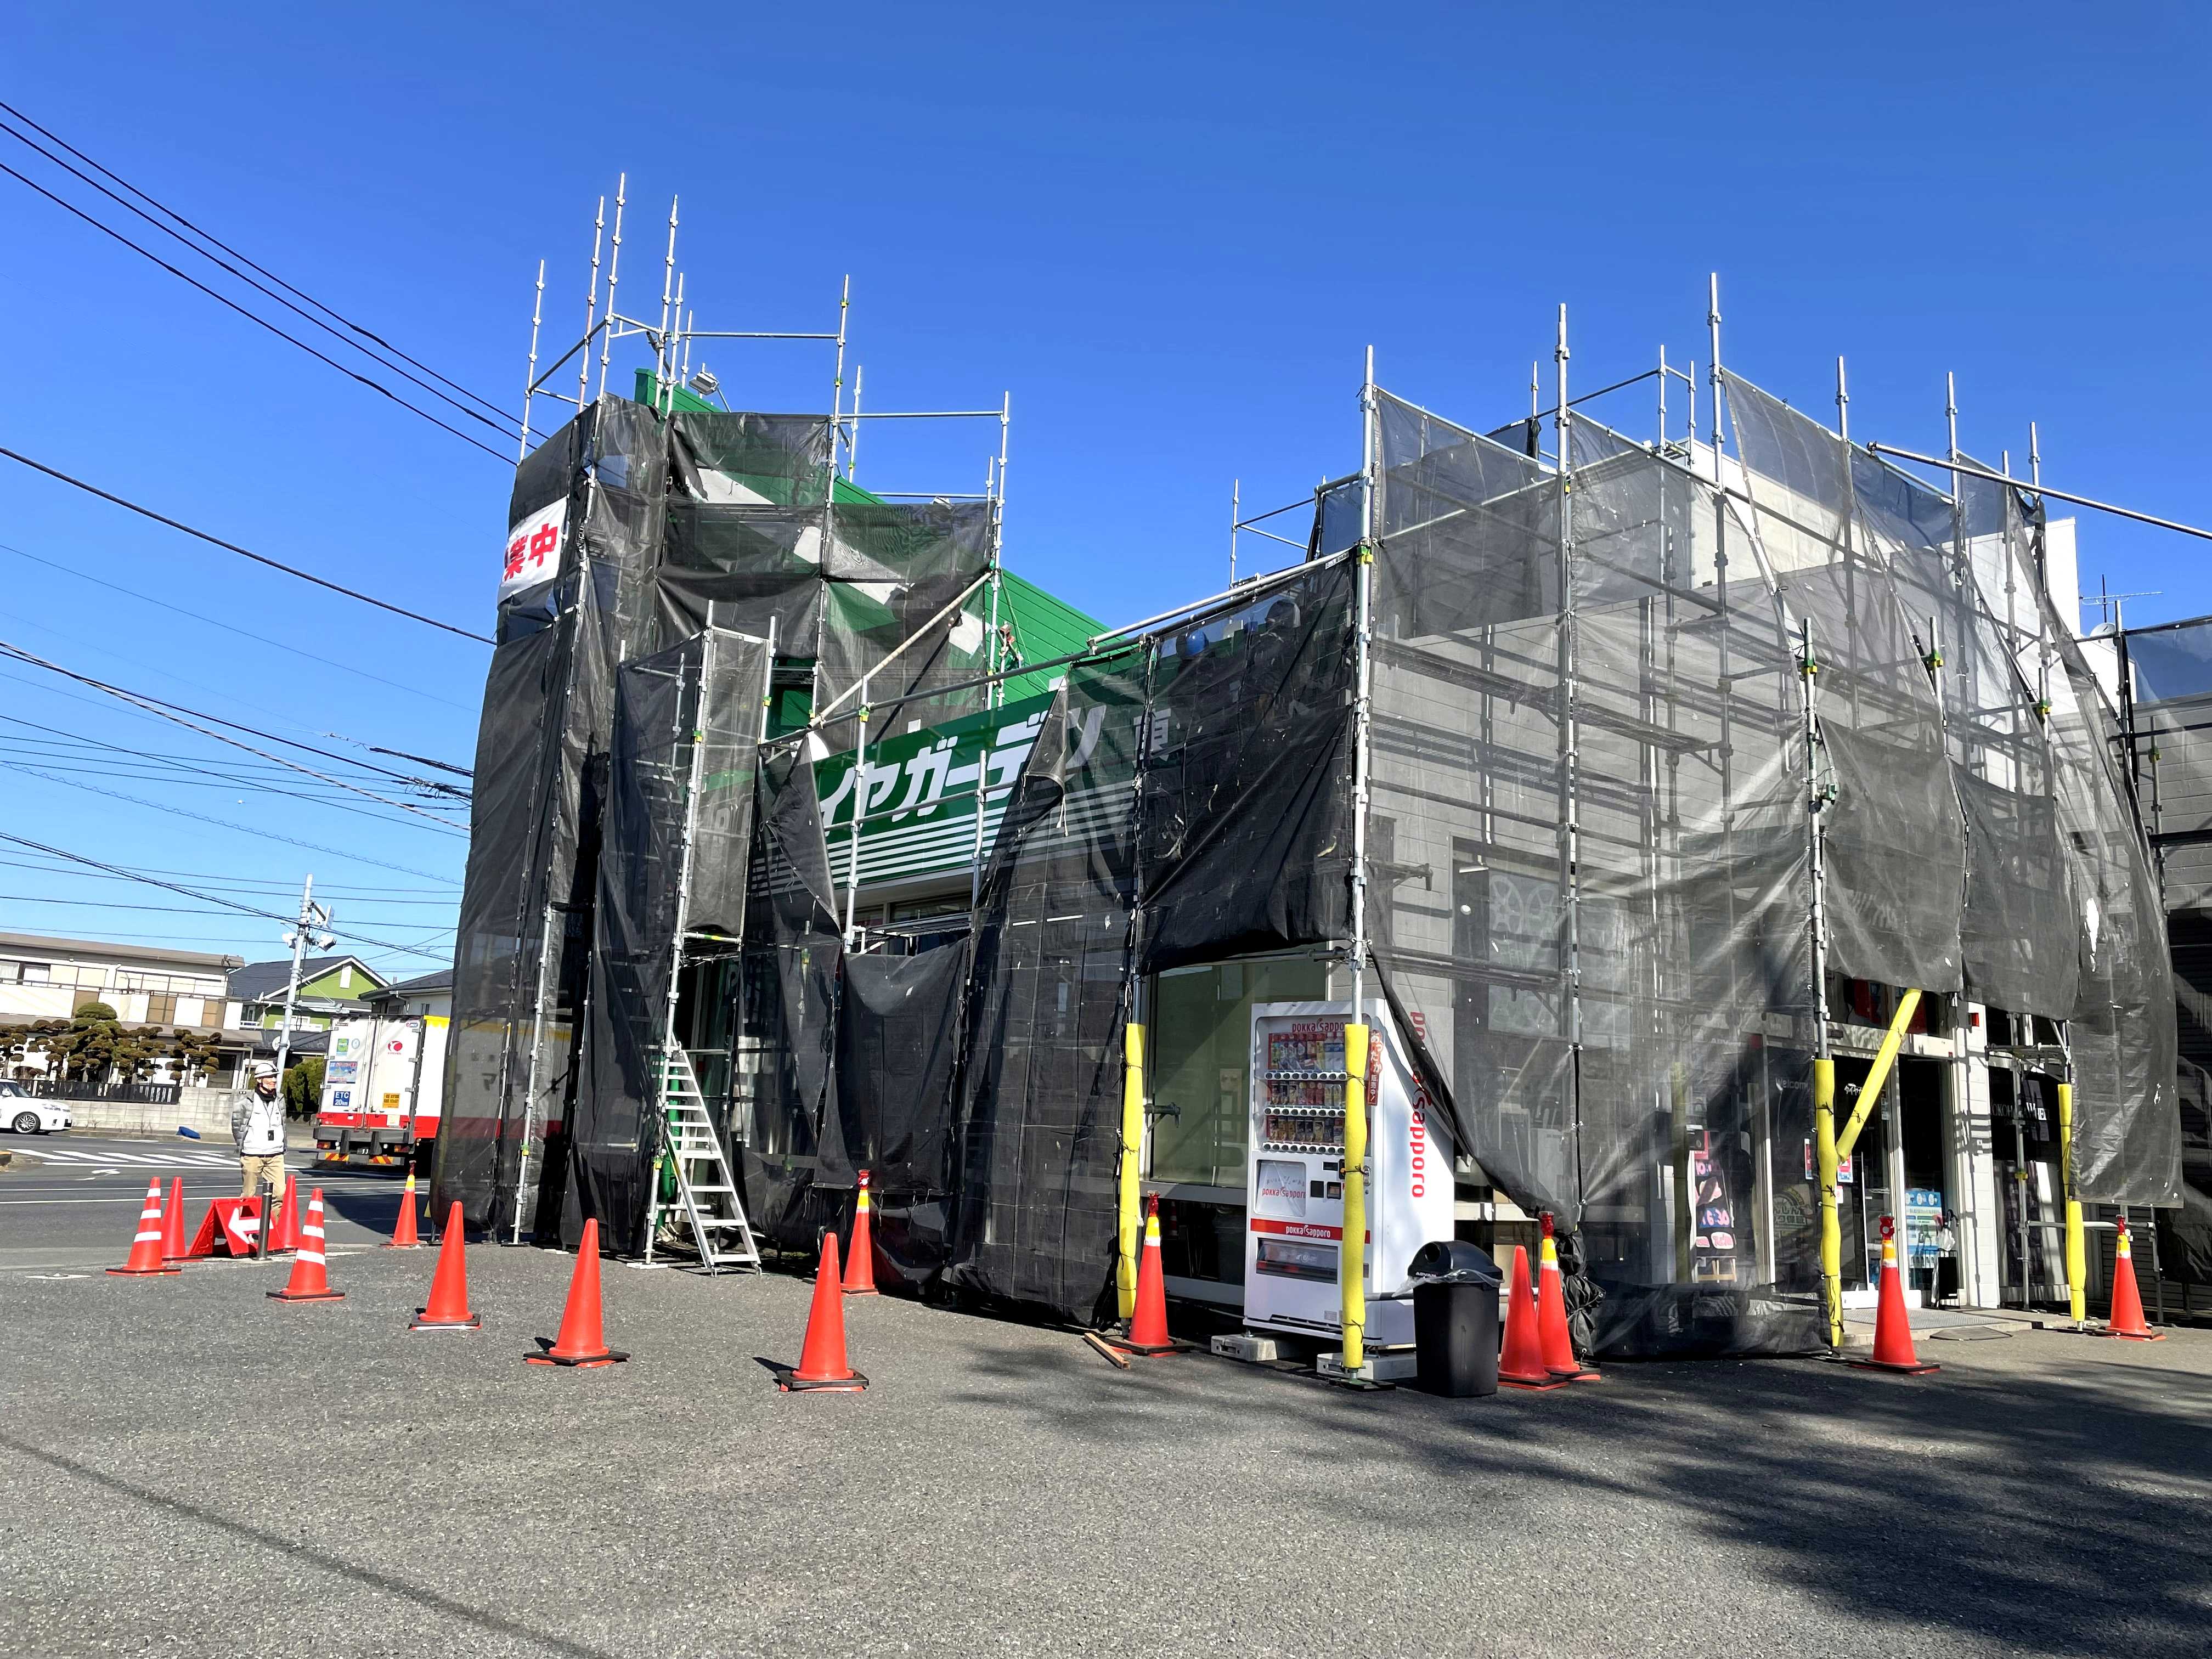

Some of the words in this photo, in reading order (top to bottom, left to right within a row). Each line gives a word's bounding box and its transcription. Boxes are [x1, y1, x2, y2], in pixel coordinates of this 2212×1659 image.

[504, 523, 558, 582] 業中
[1319, 1022, 1344, 1032] sappo
[1775, 1077, 1808, 1090] Welcom
[1285, 1226, 1304, 1234] pokka
[1306, 1227, 1331, 1238] sapporo
